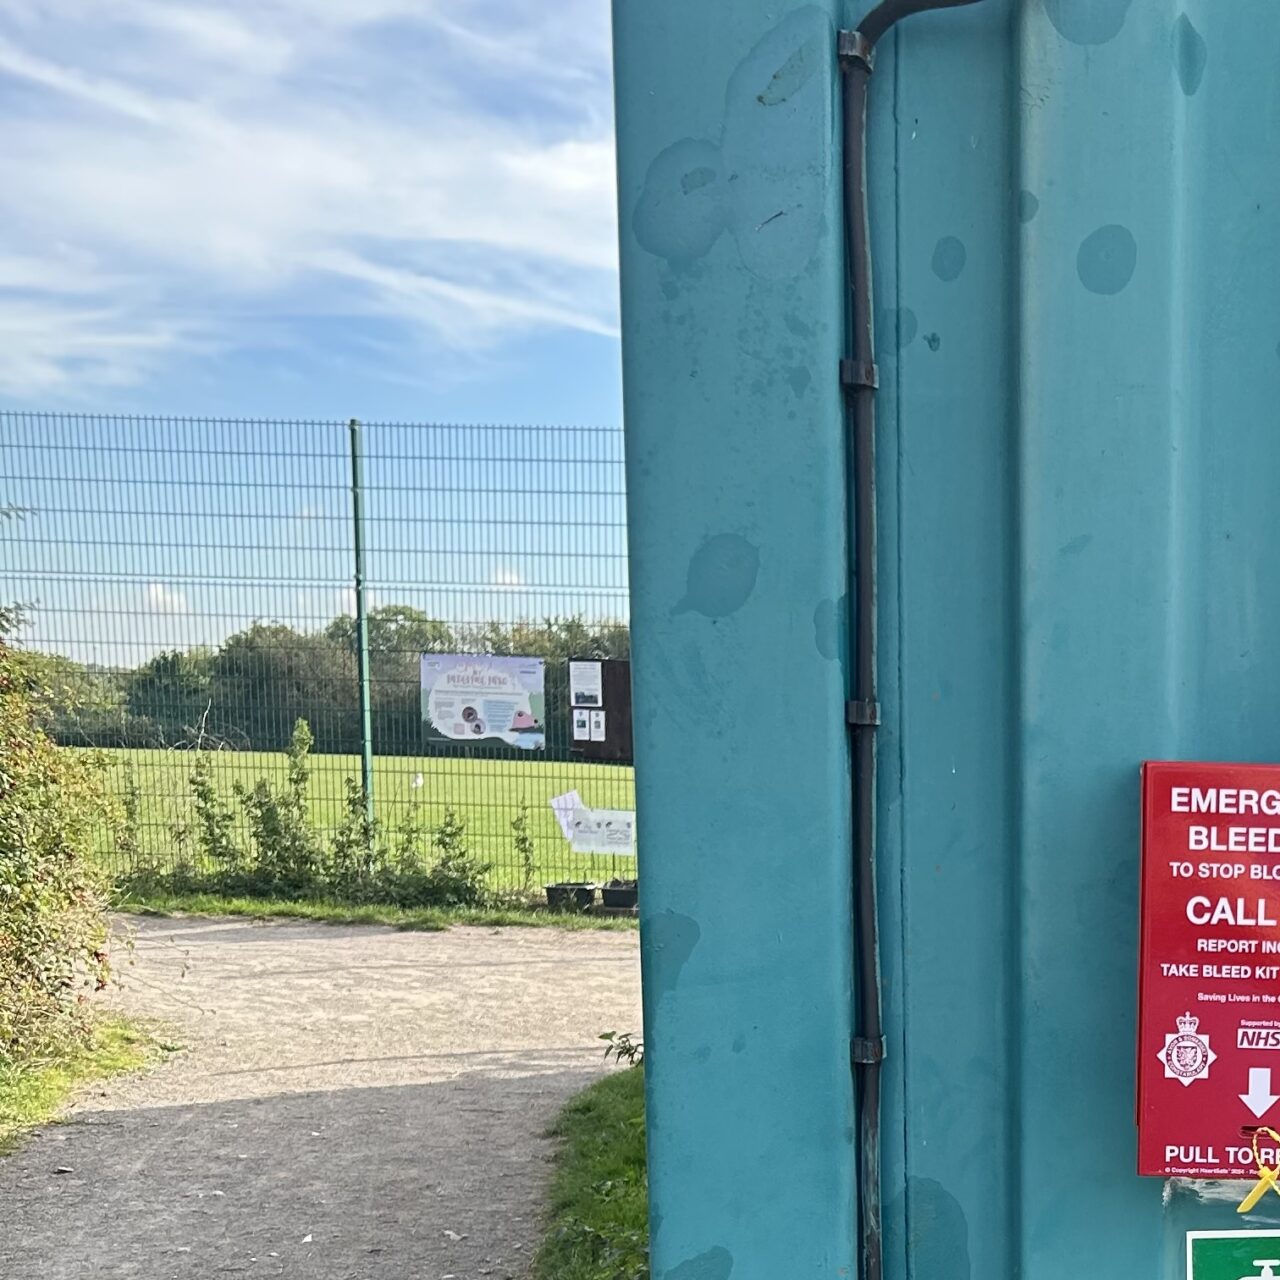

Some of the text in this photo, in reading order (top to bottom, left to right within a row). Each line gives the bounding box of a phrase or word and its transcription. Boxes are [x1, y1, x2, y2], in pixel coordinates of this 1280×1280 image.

[1169, 862, 1194, 878] TO
[1198, 863, 1245, 878] STOP
[1186, 896, 1277, 926] CALL
[1197, 939, 1258, 953] REPORT
[1161, 963, 1198, 977] TAKE
[1202, 965, 1251, 978] BLEED
[1255, 966, 1280, 980] KIT
[1197, 993, 1226, 1003] Saving
[1228, 993, 1250, 1003] Lives
[1252, 994, 1260, 1002] in
[1262, 994, 1276, 1003] the
[1240, 1031, 1280, 1047] NHS
[1165, 1146, 1220, 1164] PULL
[1225, 1146, 1254, 1165] TO
